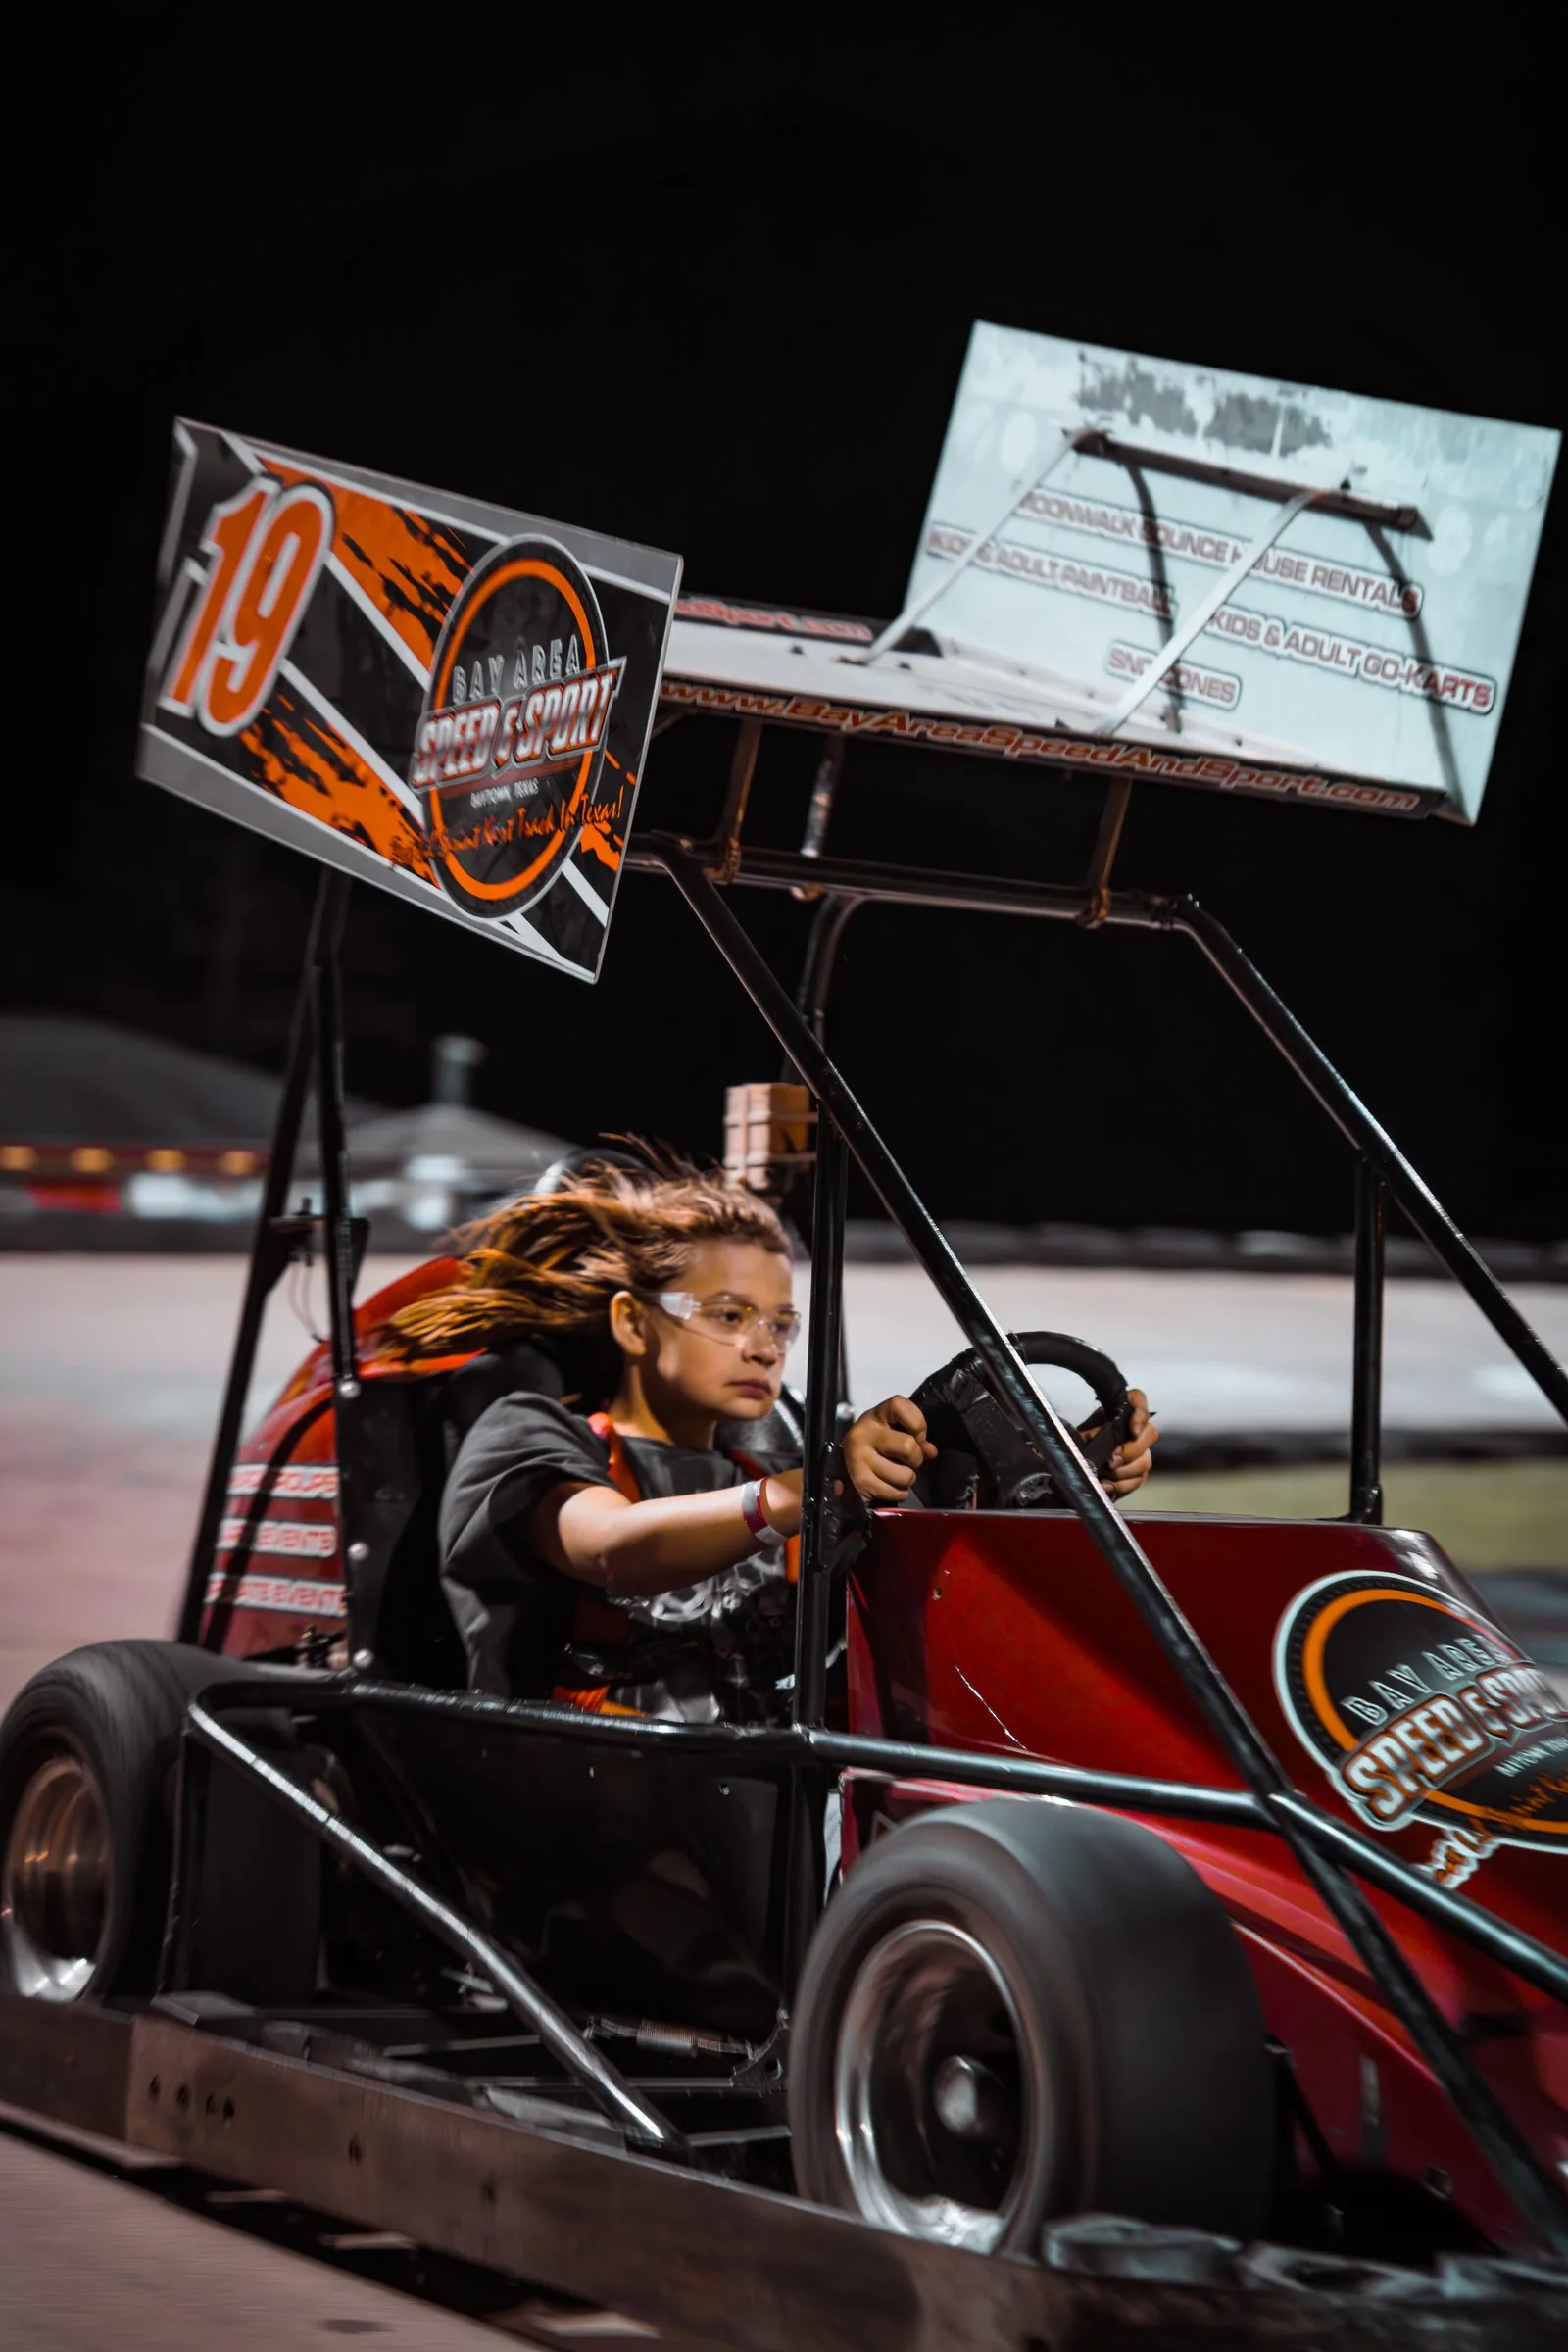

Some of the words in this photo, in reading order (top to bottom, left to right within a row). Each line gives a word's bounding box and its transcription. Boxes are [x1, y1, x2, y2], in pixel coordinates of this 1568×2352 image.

[155, 475, 334, 737] 19
[997, 545, 1059, 580] ADULT
[1311, 563, 1420, 614] RENTALS
[452, 654, 505, 705] BAY
[513, 633, 581, 690] AREA
[1209, 609, 1261, 641] KIDS
[1263, 618, 1281, 648] &
[1284, 631, 1362, 670] ADULT
[1362, 652, 1493, 708] GO-KARTS
[410, 700, 502, 789] SPEED
[514, 668, 619, 763] SPORT
[577, 784, 624, 826] Texas!
[1340, 1663, 1434, 1726] BAY
[1421, 1633, 1514, 1682] AREA
[1343, 1693, 1489, 1820] SPEED
